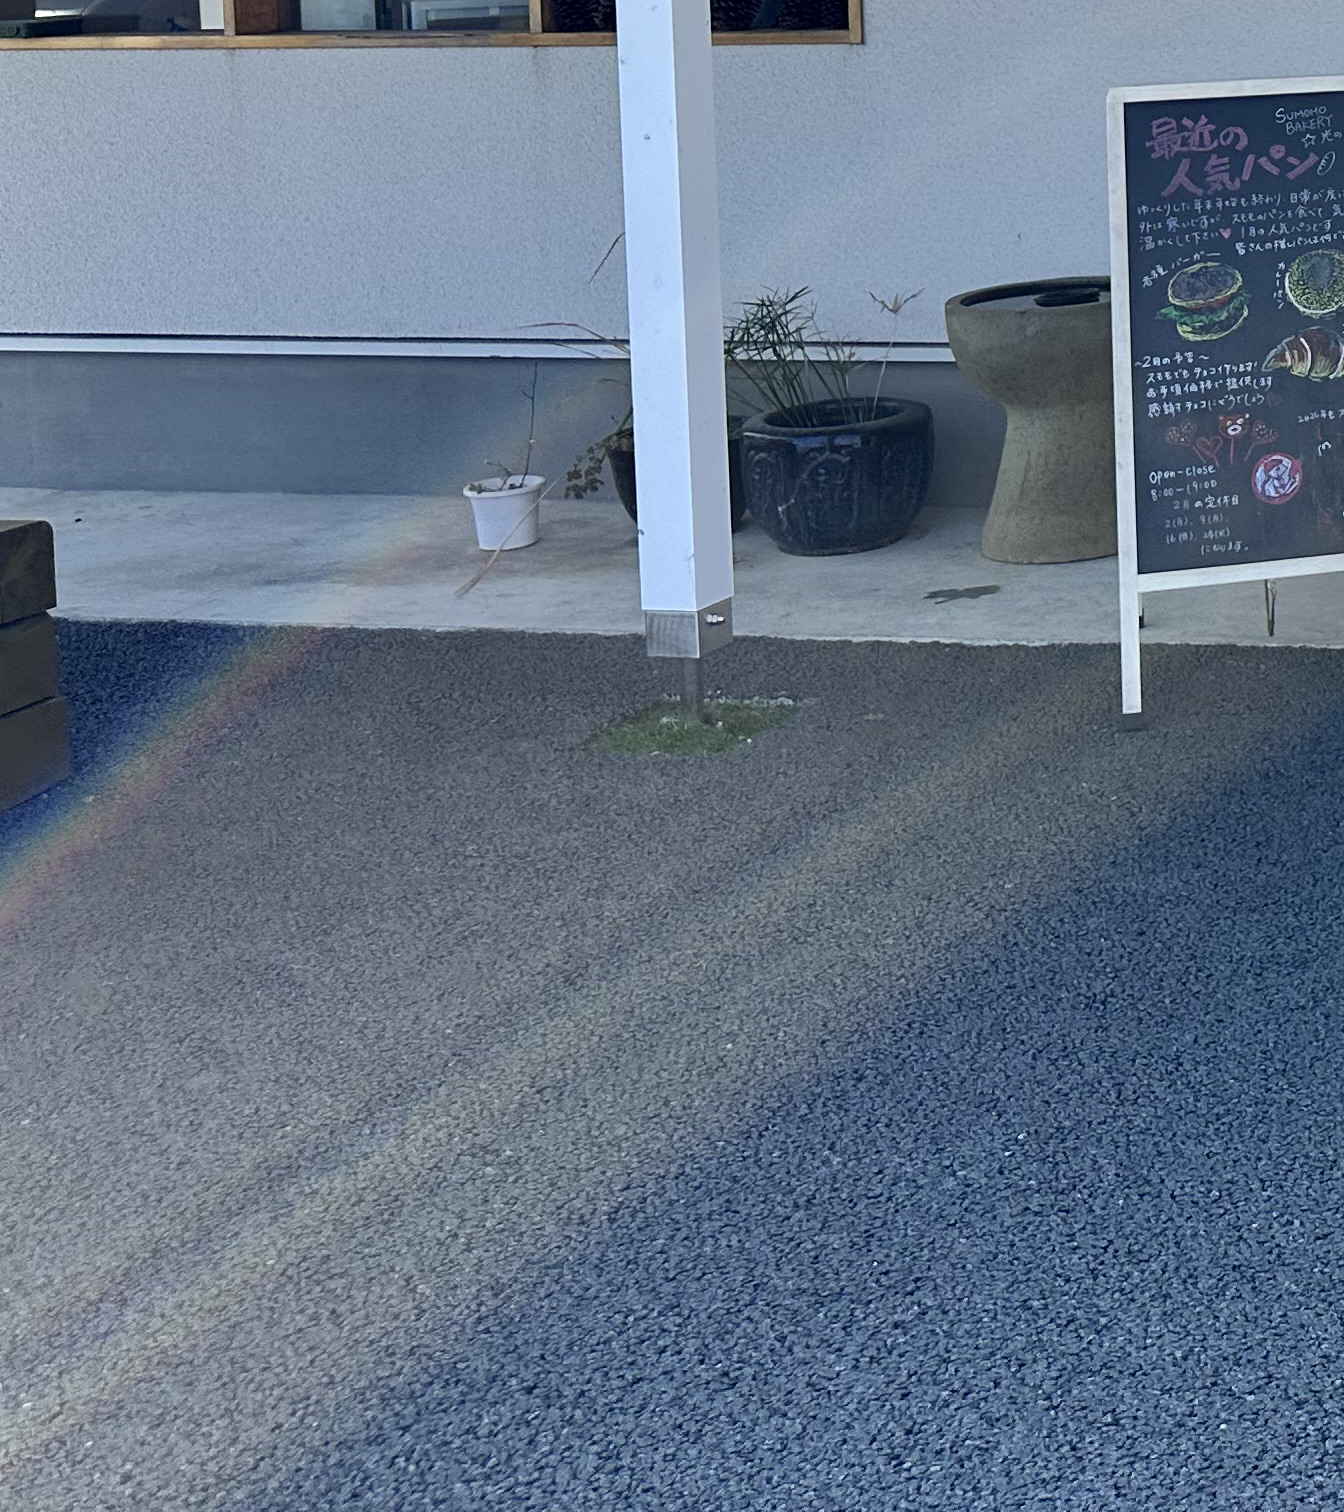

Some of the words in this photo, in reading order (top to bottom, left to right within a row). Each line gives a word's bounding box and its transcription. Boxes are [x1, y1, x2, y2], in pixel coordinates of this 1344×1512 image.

[1275, 106, 1327, 123] SUMOMO
[1285, 114, 1333, 135] BAKERY
[1145, 114, 1249, 160] 最近の
[1160, 144, 1319, 197] 人気パン
